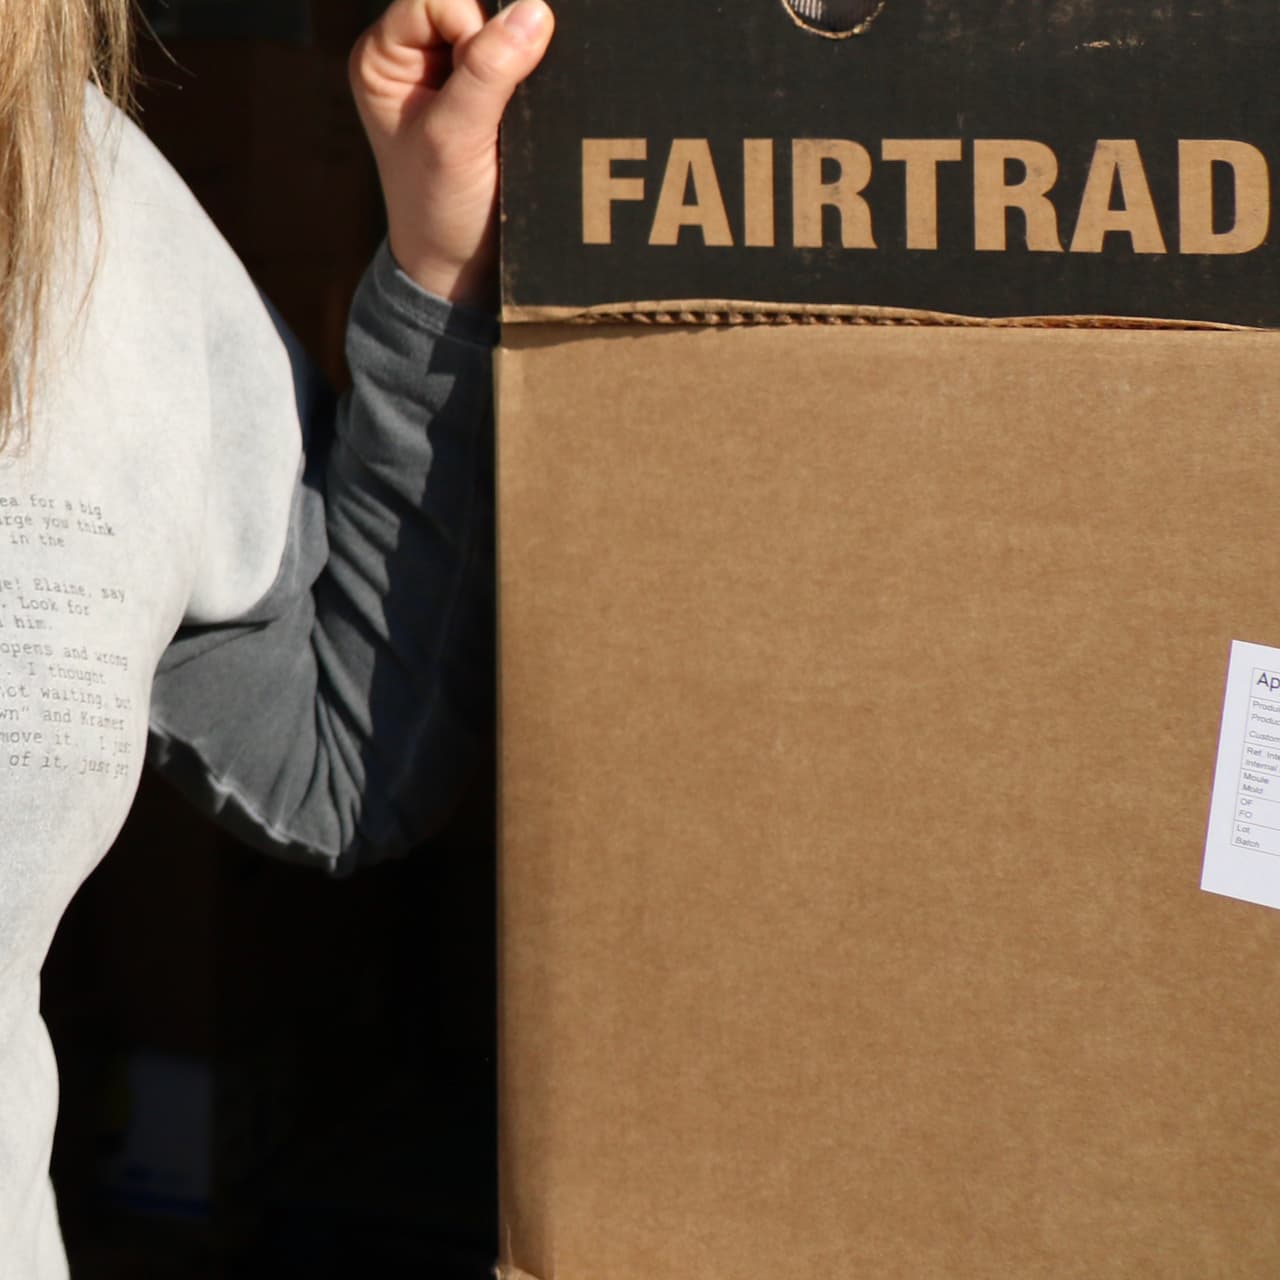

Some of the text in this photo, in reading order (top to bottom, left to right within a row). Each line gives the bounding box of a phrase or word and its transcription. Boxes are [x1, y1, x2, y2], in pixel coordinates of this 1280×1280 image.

[580, 137, 1272, 256] FAIRTRAD
[30, 495, 55, 508] for
[80, 500, 102, 519] big
[43, 517, 69, 529] you
[77, 519, 115, 536] think
[10, 532, 29, 544] in
[40, 534, 65, 547] the
[102, 587, 126, 603] say
[18, 597, 58, 611] Look
[68, 600, 91, 616] for
[13, 615, 53, 630] him.
[0, 642, 53, 657] opens
[64, 646, 88, 660] and
[96, 651, 128, 671] wrong
[48, 666, 106, 686] thought
[43, 709, 125, 730] and Kramer
[9, 751, 31, 766] of
[79, 758, 110, 774] just
[1243, 772, 1269, 785] Moule
[1236, 824, 1250, 834] Lot
